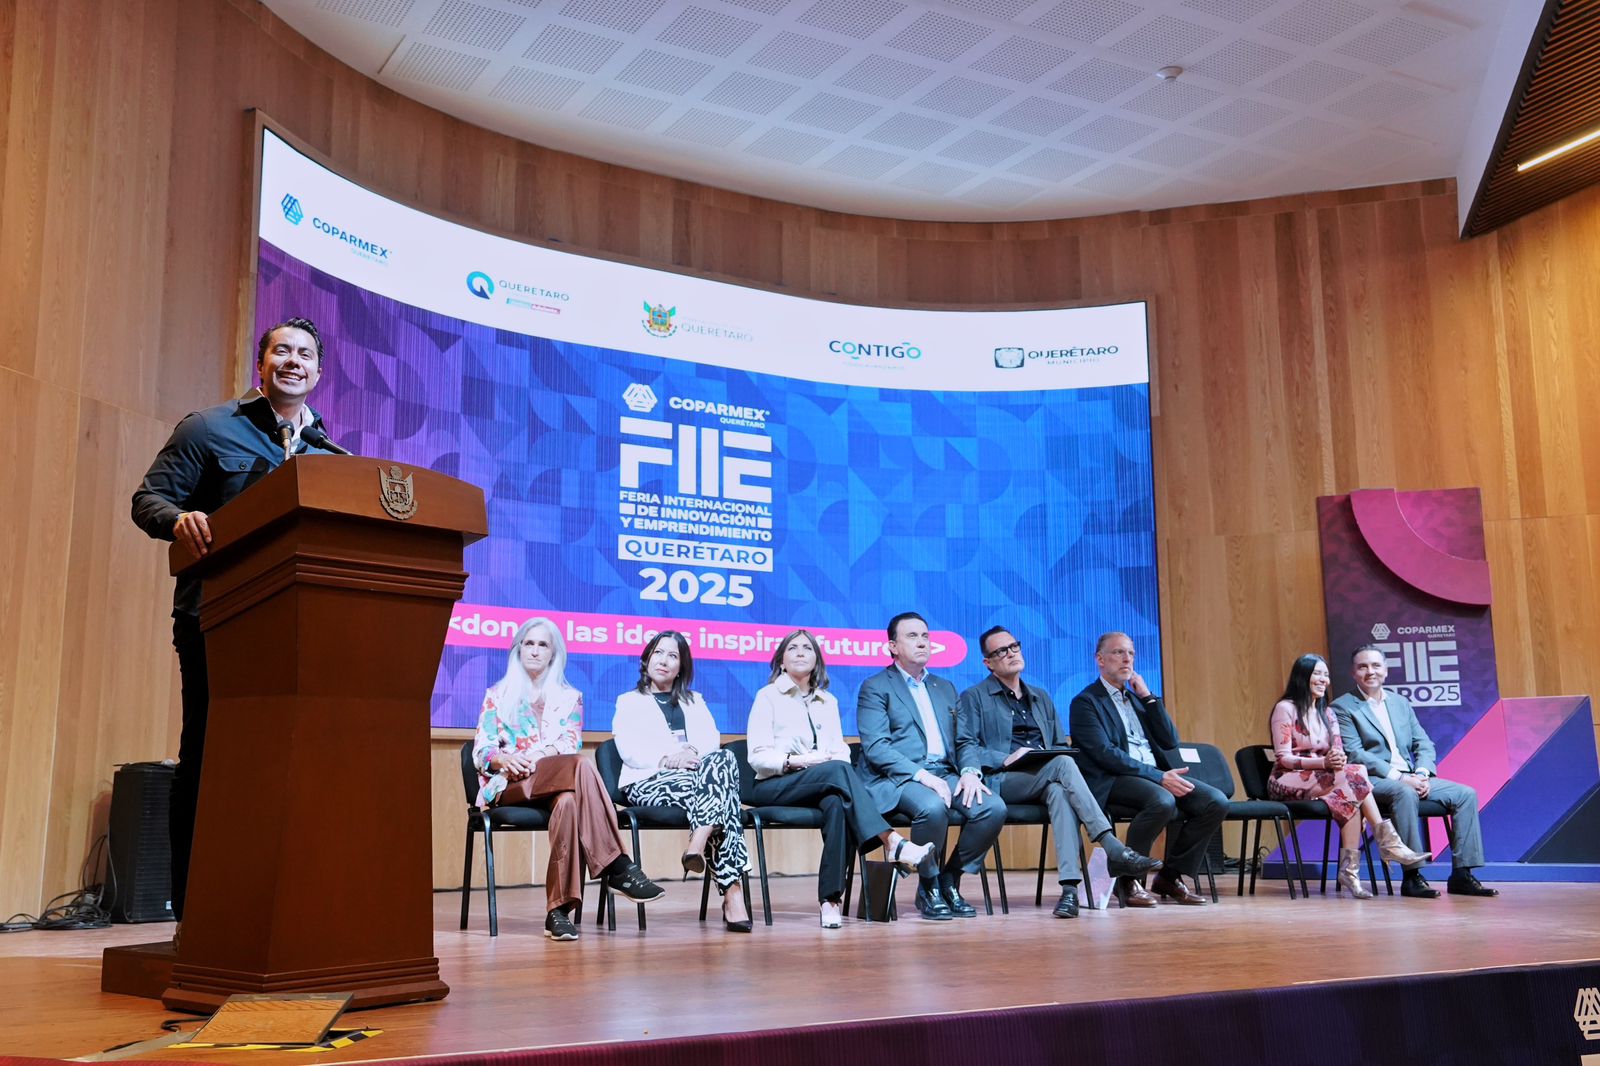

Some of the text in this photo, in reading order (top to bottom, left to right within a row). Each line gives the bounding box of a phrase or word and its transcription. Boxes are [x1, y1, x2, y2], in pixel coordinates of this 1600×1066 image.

[313, 217, 388, 259] COPARMEX
[829, 340, 921, 359] CONTIGO
[719, 417, 766, 429] QUERÉTARO
[619, 490, 772, 516] FERIA INTERNACIONAL
[637, 503, 756, 527] DE INNOVACIÓN
[620, 516, 772, 541] Y EMPRENDIMIENTO
[625, 539, 767, 566] QUERÉTARO
[638, 567, 754, 607] 2025
[567, 620, 608, 642] las
[616, 622, 692, 646] ides
[1397, 625, 1455, 634] COPARMEX
[1383, 685, 1460, 702] RO25
